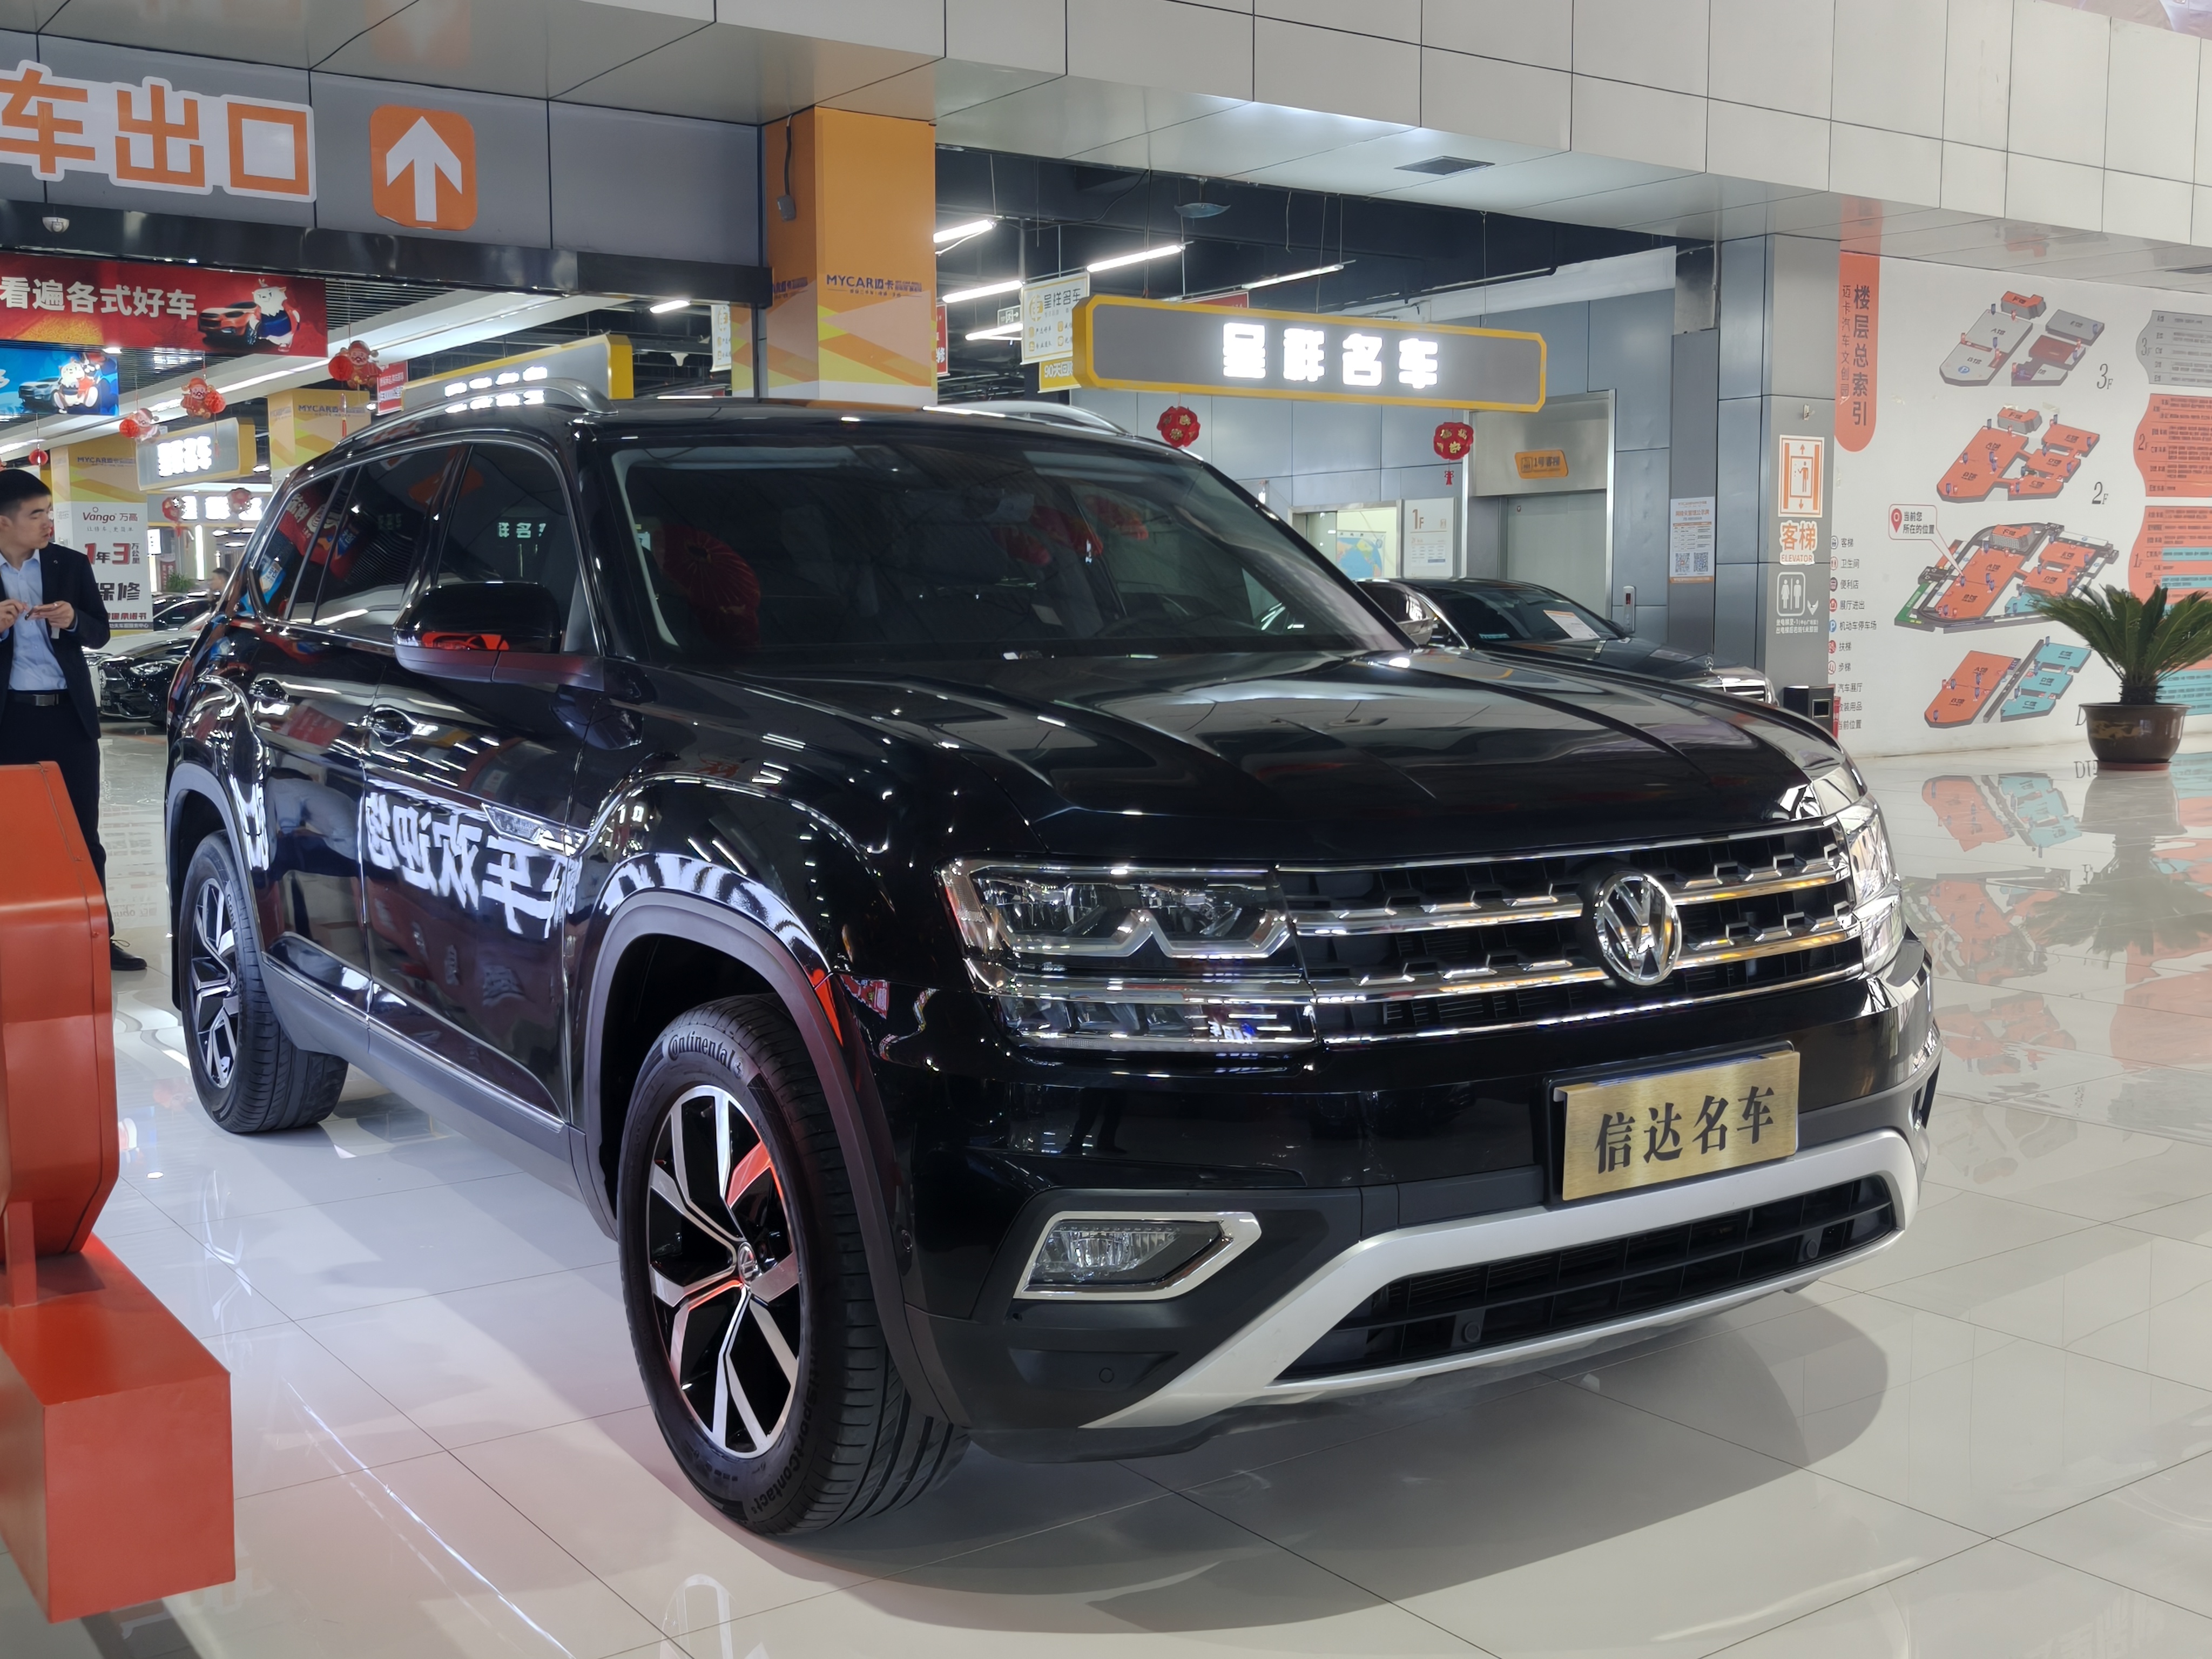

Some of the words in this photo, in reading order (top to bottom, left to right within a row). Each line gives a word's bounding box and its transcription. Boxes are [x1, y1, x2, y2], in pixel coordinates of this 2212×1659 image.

[0, 68, 311, 197] 车出口
[0, 276, 197, 320] 看遍各式好车
[1851, 284, 1870, 426] 楼层总索引
[2096, 363, 2113, 389] 3F
[2091, 481, 2109, 504] 2F
[83, 512, 116, 523] Vango
[1413, 509, 1424, 529] 1F
[1904, 511, 1923, 522] 当前您
[1903, 524, 1935, 534] 所在的位置
[1782, 523, 1817, 551] 客梯
[1840, 538, 1854, 548] 客梯
[1840, 559, 1859, 569] 卫生间
[1840, 579, 1859, 590] 便利店
[1839, 600, 1865, 610] 展厅进出
[1839, 621, 1877, 631] 机动车停车场
[1839, 642, 1851, 651] 扶梯
[1838, 663, 1851, 672] 步梯
[1838, 683, 1862, 693] 汽车展厅
[668, 1032, 736, 1071] Continental
[1594, 1085, 1775, 1175] 信达名车
